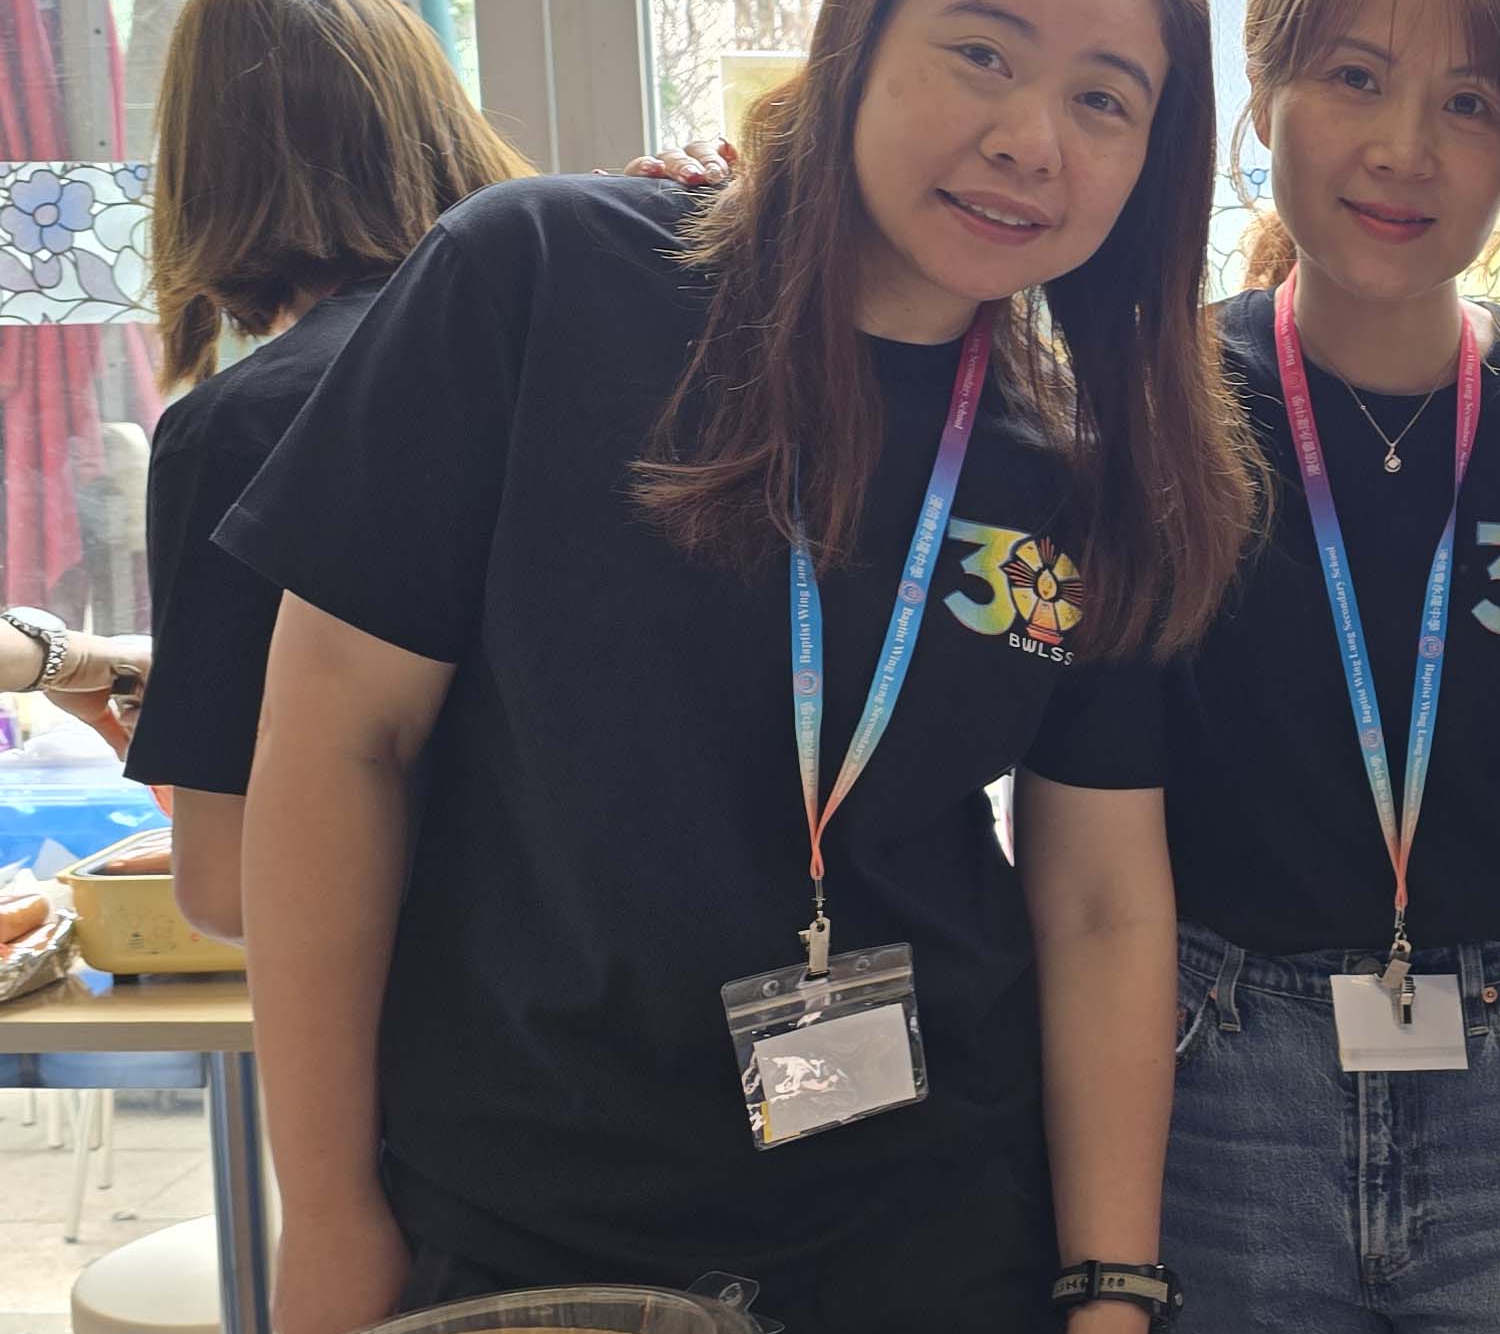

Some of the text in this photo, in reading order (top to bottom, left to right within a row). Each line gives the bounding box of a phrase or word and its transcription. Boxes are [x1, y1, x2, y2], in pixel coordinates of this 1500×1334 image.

[797, 589, 811, 621] Wing
[896, 607, 914, 643] Baptist
[1329, 546, 1372, 723] Baptist Wing Lung Secondary School
[799, 622, 815, 665] Baptist
[884, 644, 905, 673] Wing
[1008, 633, 1074, 666] BWLSS
[874, 673, 895, 704] Lung
[1420, 663, 1436, 699] Baptist
[1416, 699, 1431, 727] Wing
[1414, 729, 1427, 756] Lung
